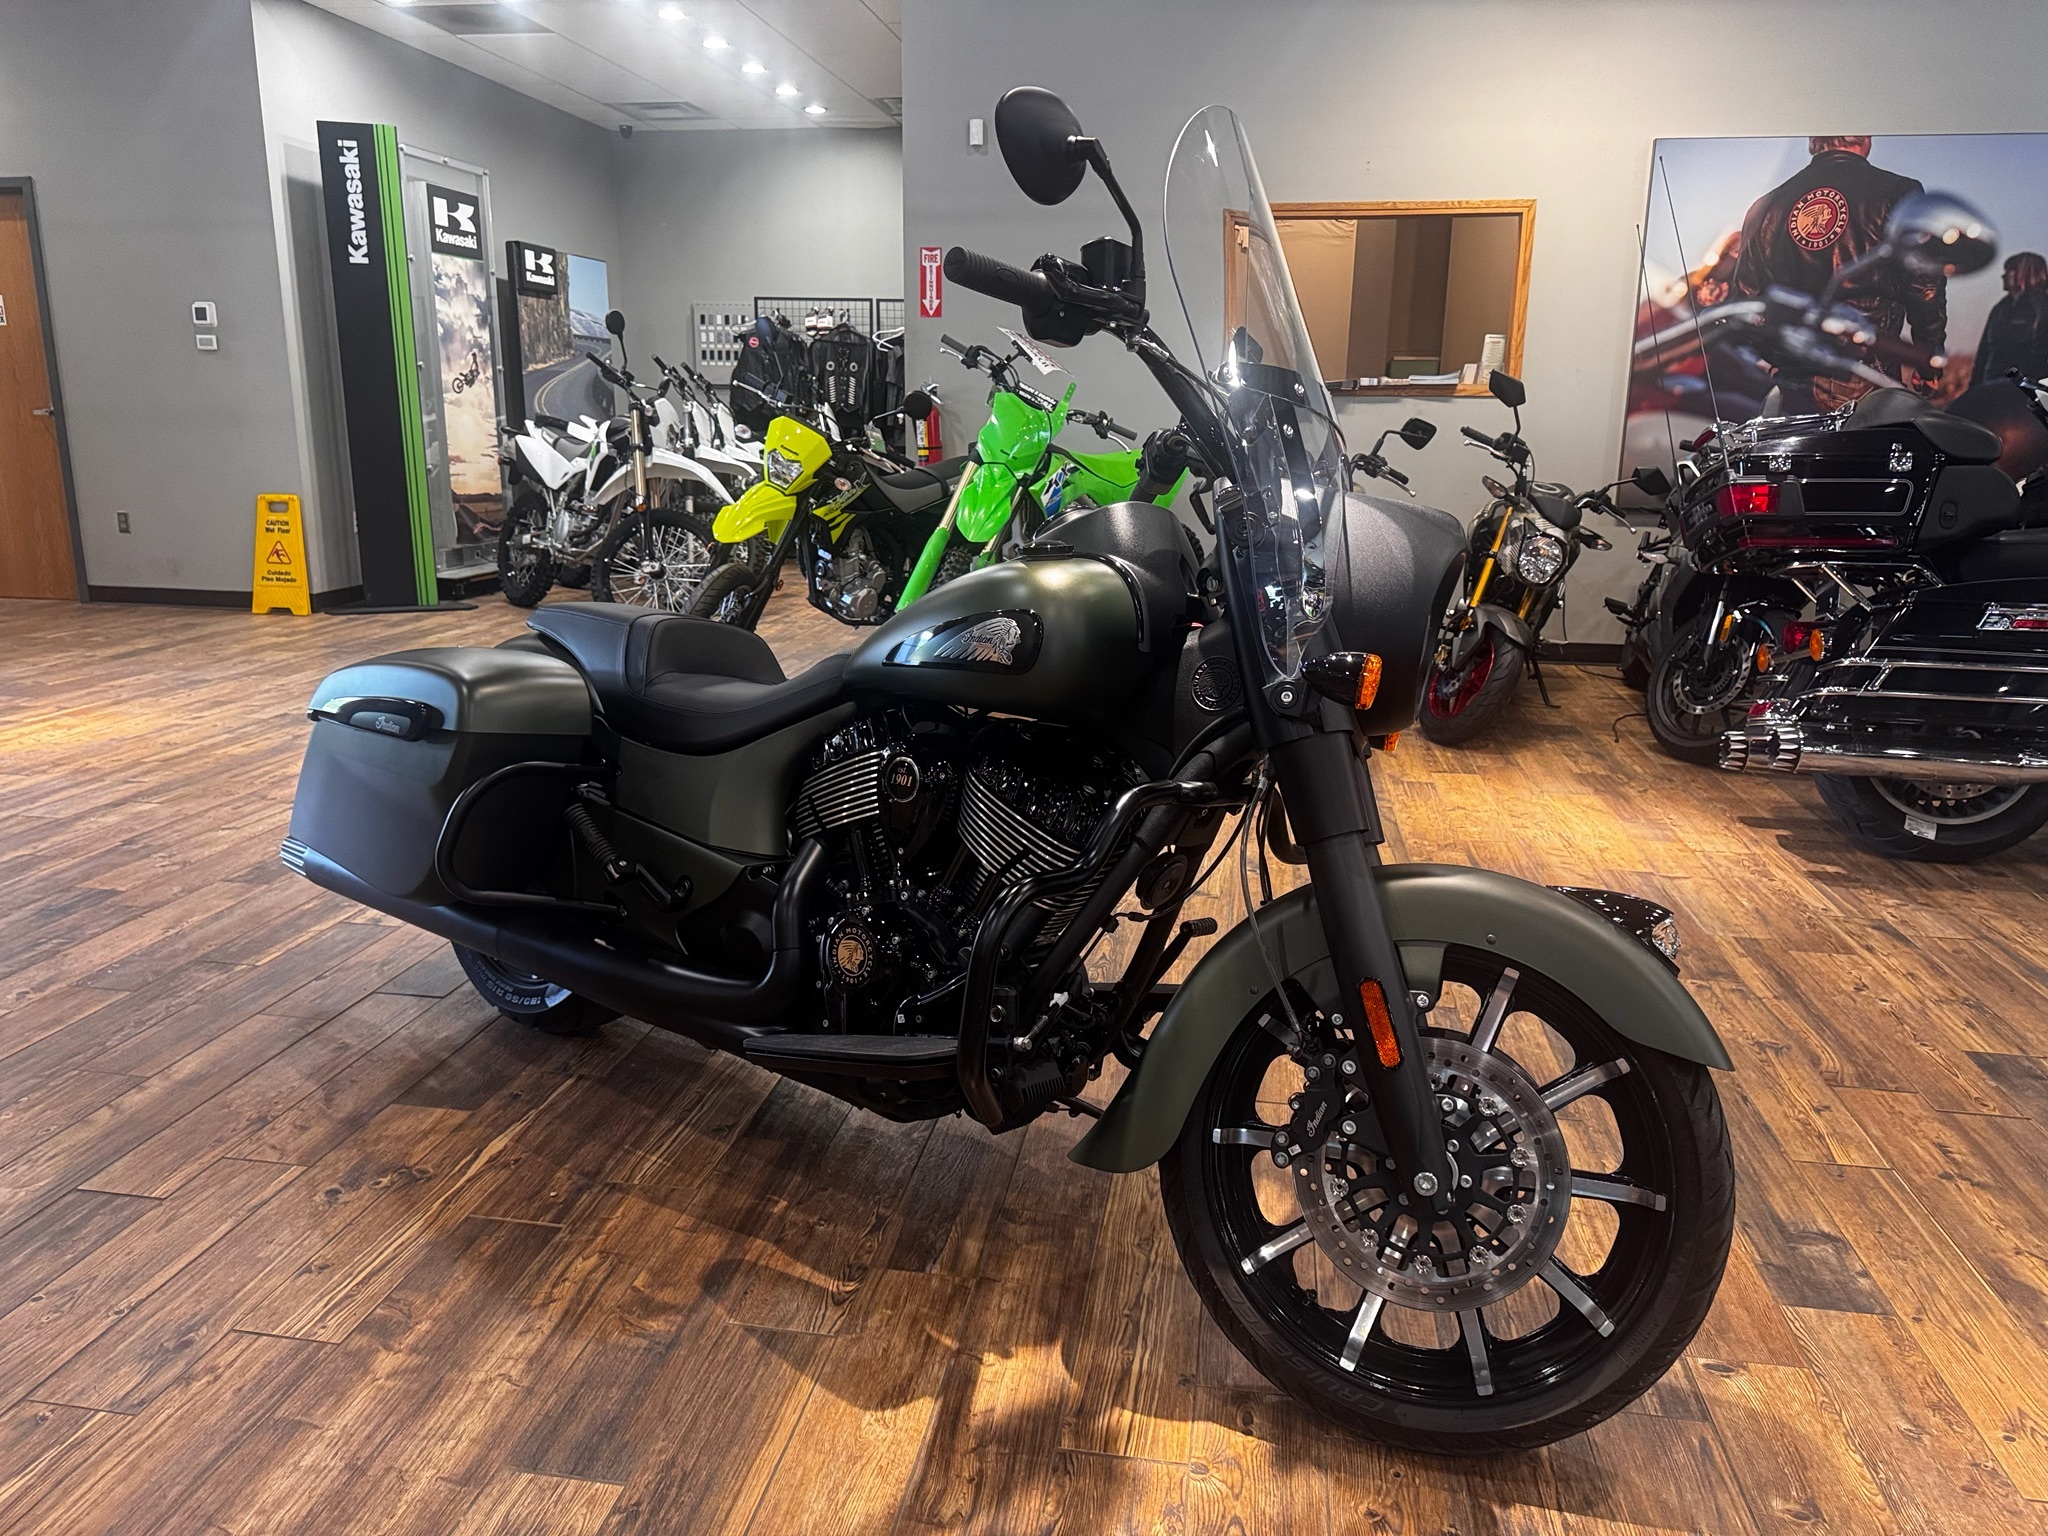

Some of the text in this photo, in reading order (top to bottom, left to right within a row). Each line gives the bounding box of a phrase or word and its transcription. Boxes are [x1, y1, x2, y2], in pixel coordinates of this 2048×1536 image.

[337, 139, 370, 265] Kawasaki
[1790, 190, 1848, 240] INDIAN MOTORCYCLE
[435, 227, 478, 250] Kawasaki
[1808, 238, 1829, 248] 1901
[923, 253, 939, 264] FIRE
[261, 575, 275, 583] Piso
[266, 569, 292, 577] Cuidado
[961, 628, 994, 645] Indian
[375, 715, 401, 735] Indian
[890, 773, 913, 787] 1901
[832, 927, 874, 978] INDIAN MOTORCYCLE
[841, 974, 858, 984] 1901
[1306, 1100, 1329, 1138] Indian
